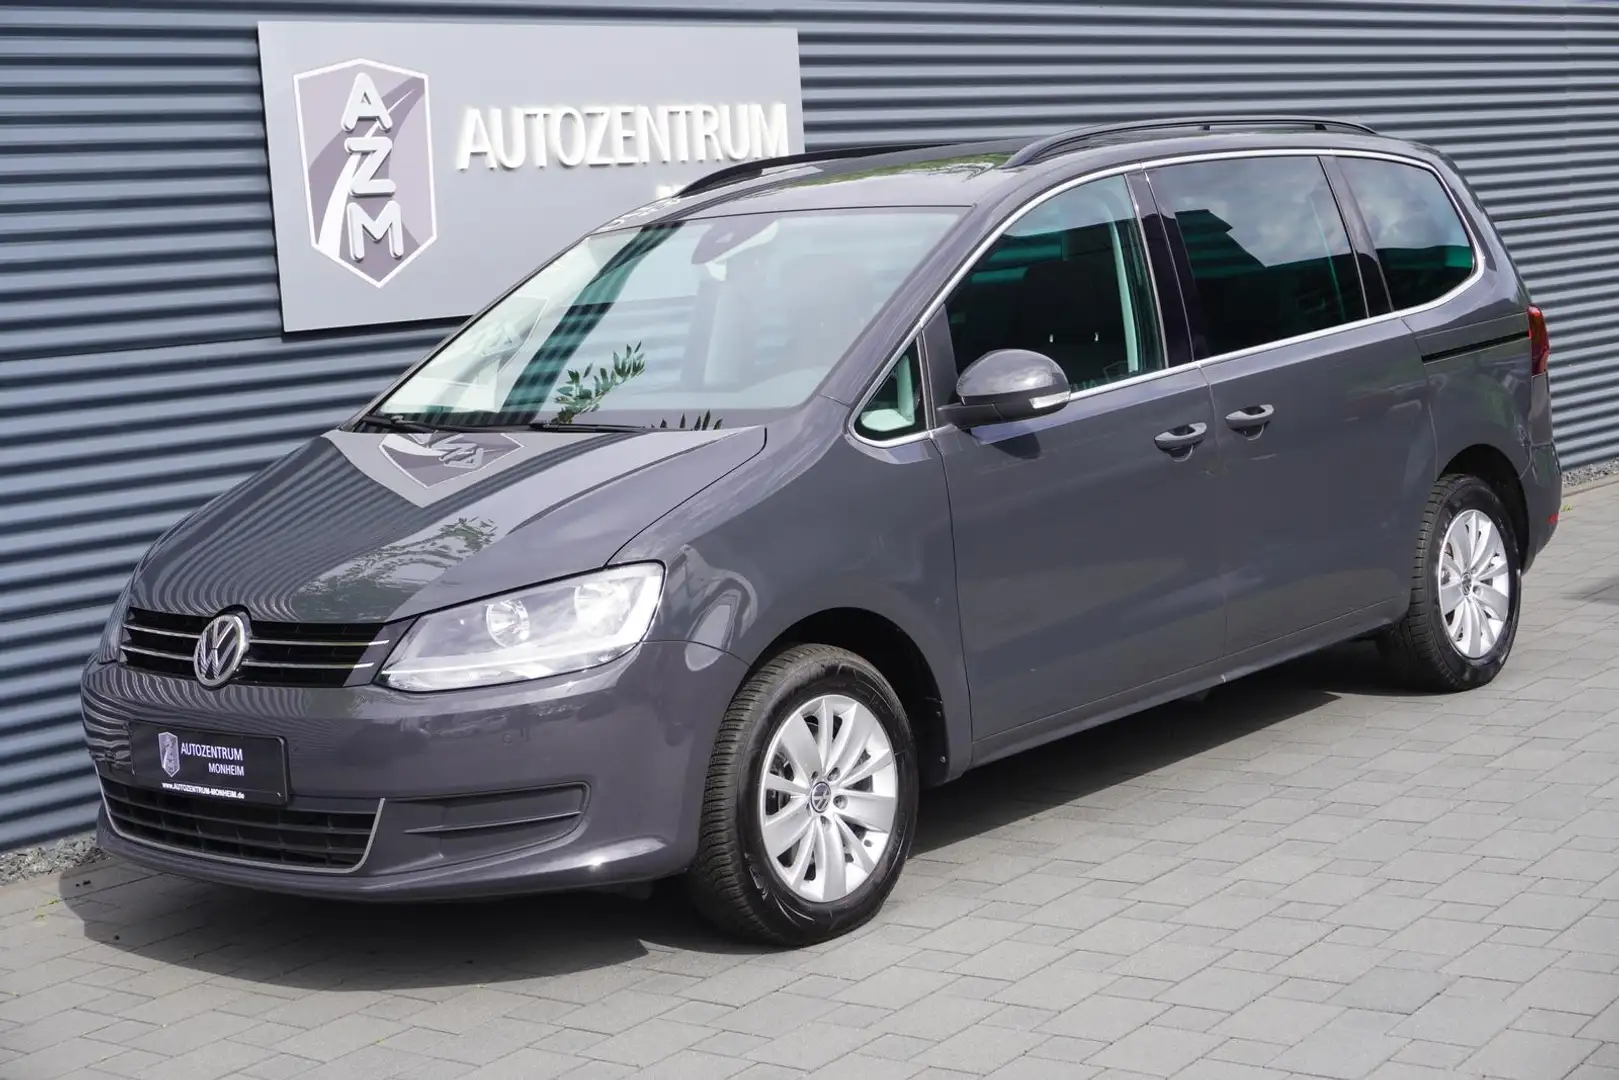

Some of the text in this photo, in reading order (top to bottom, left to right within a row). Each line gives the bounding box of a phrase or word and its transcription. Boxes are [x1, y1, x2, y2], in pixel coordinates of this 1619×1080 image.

[456, 102, 789, 171] AUTOZENTRUM
[180, 742, 244, 761] AUTOZENTRUM
[208, 762, 245, 777] MONHEIM
[161, 782, 245, 799] www.AUTOZENTRUM-MONHEIM.de
